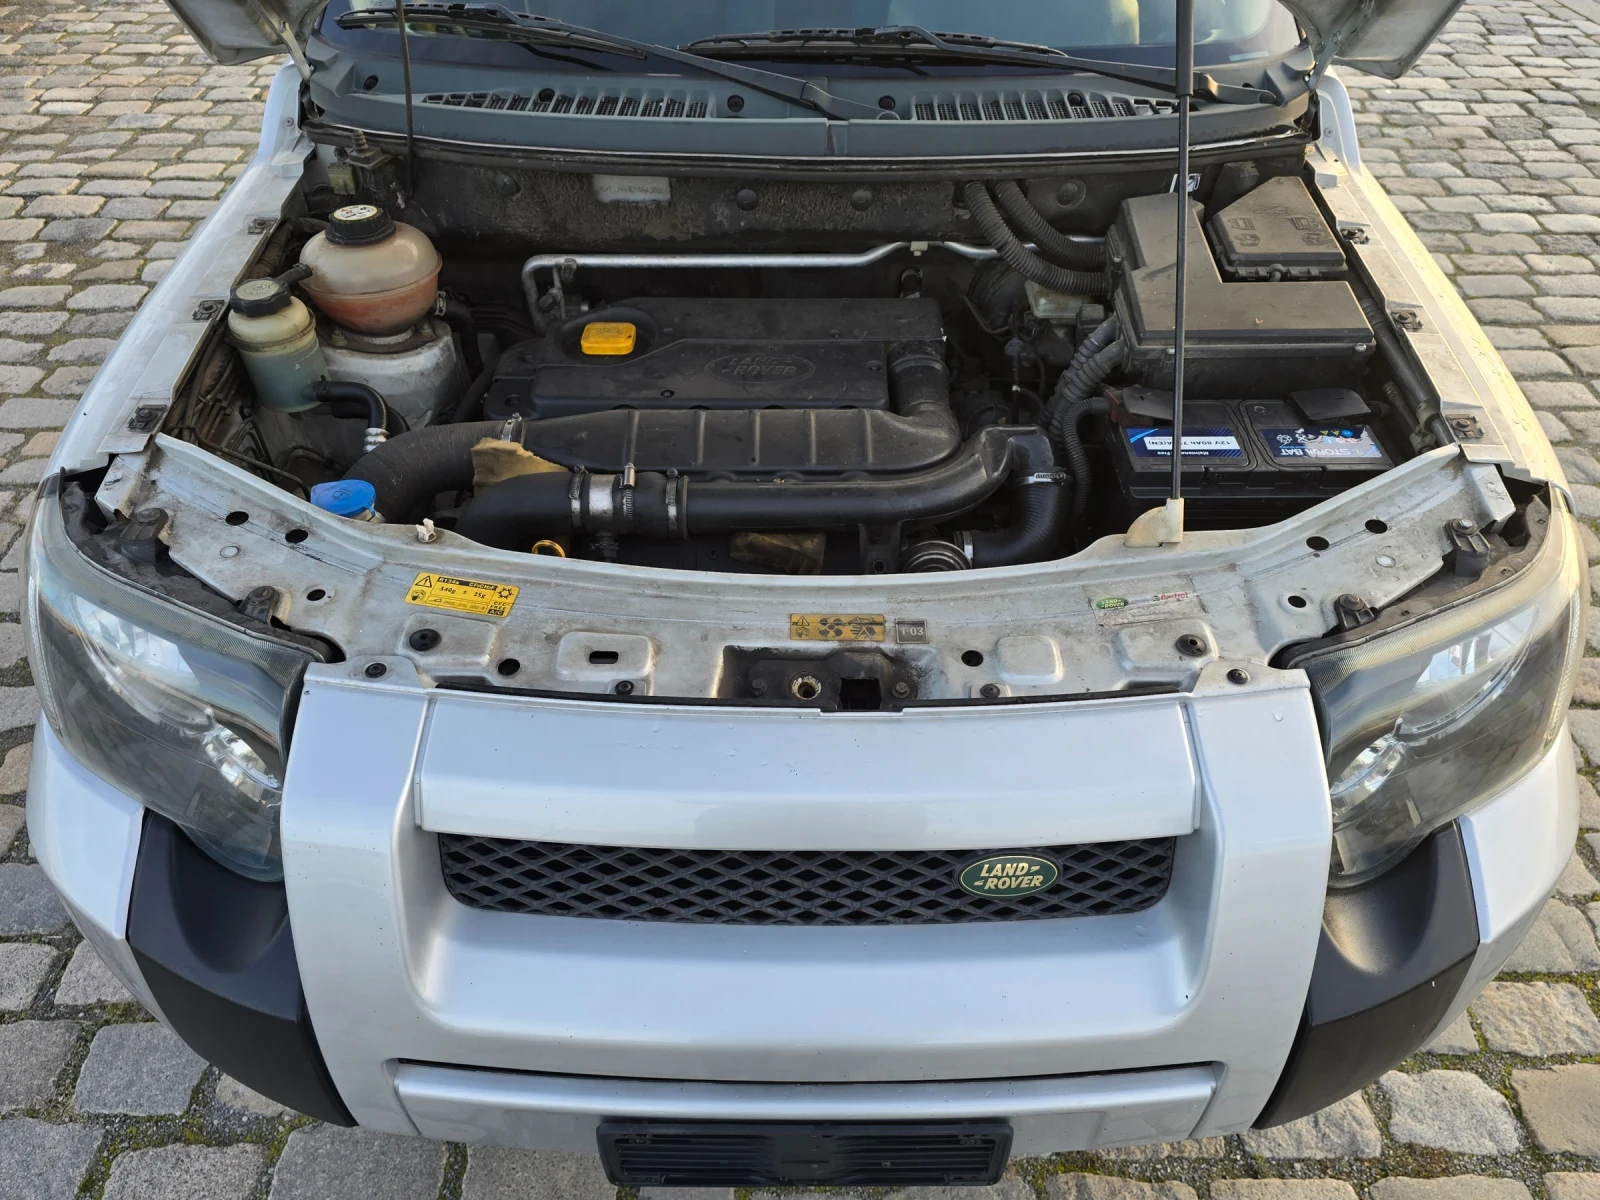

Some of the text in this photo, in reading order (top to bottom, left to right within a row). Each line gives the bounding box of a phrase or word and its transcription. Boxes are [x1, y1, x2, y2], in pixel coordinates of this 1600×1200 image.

[733, 365, 797, 375] ROVER
[1280, 448, 1304, 456] BAT
[438, 577, 460, 585] R134a
[440, 586, 456, 595] 540g
[473, 591, 486, 599] 25g
